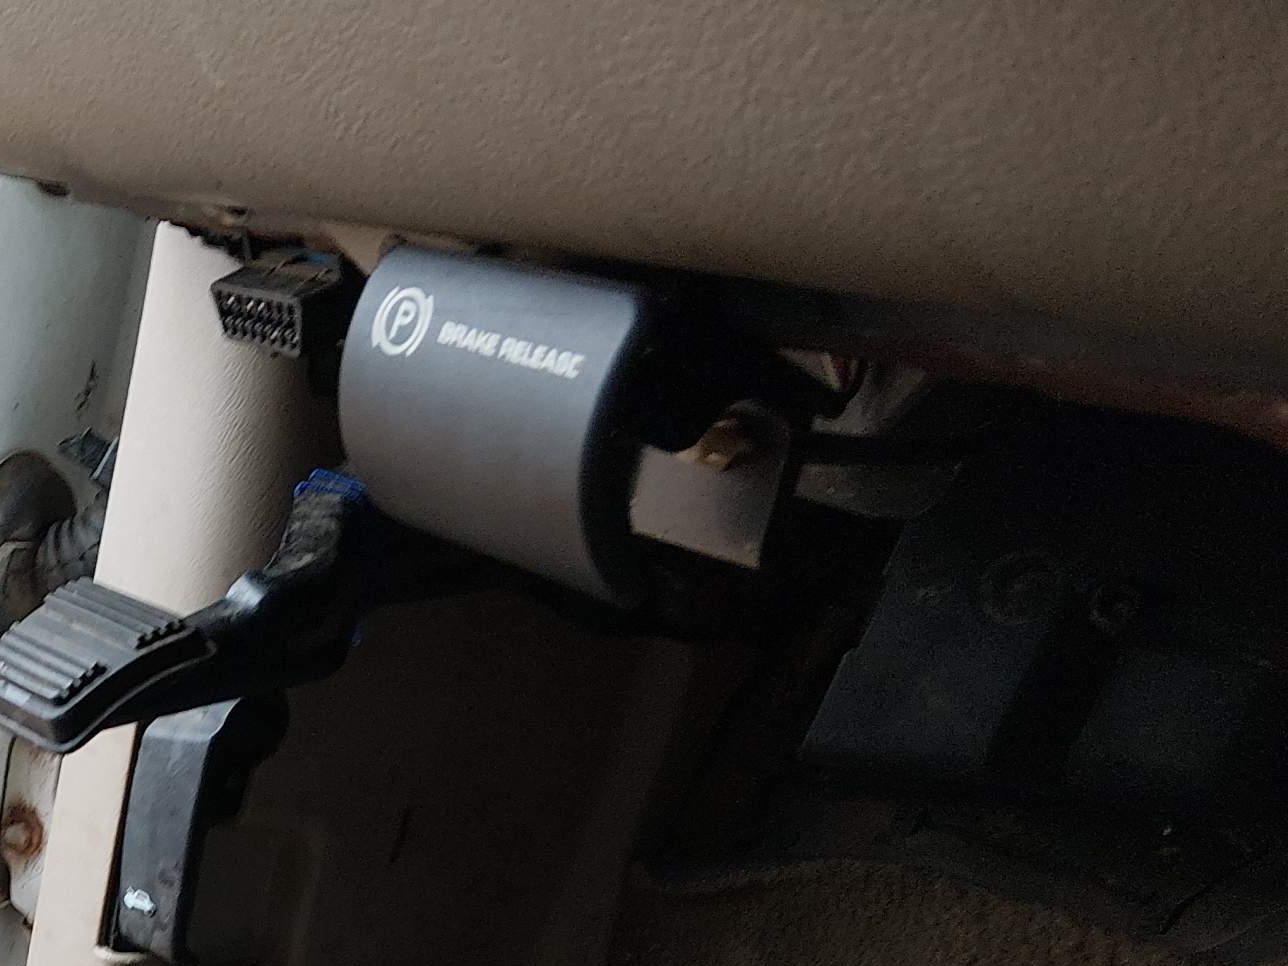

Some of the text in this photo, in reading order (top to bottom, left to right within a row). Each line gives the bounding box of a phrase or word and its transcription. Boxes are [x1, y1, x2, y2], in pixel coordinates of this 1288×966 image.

[389, 300, 417, 339] P
[437, 320, 585, 379] BRAKE RELEASE
